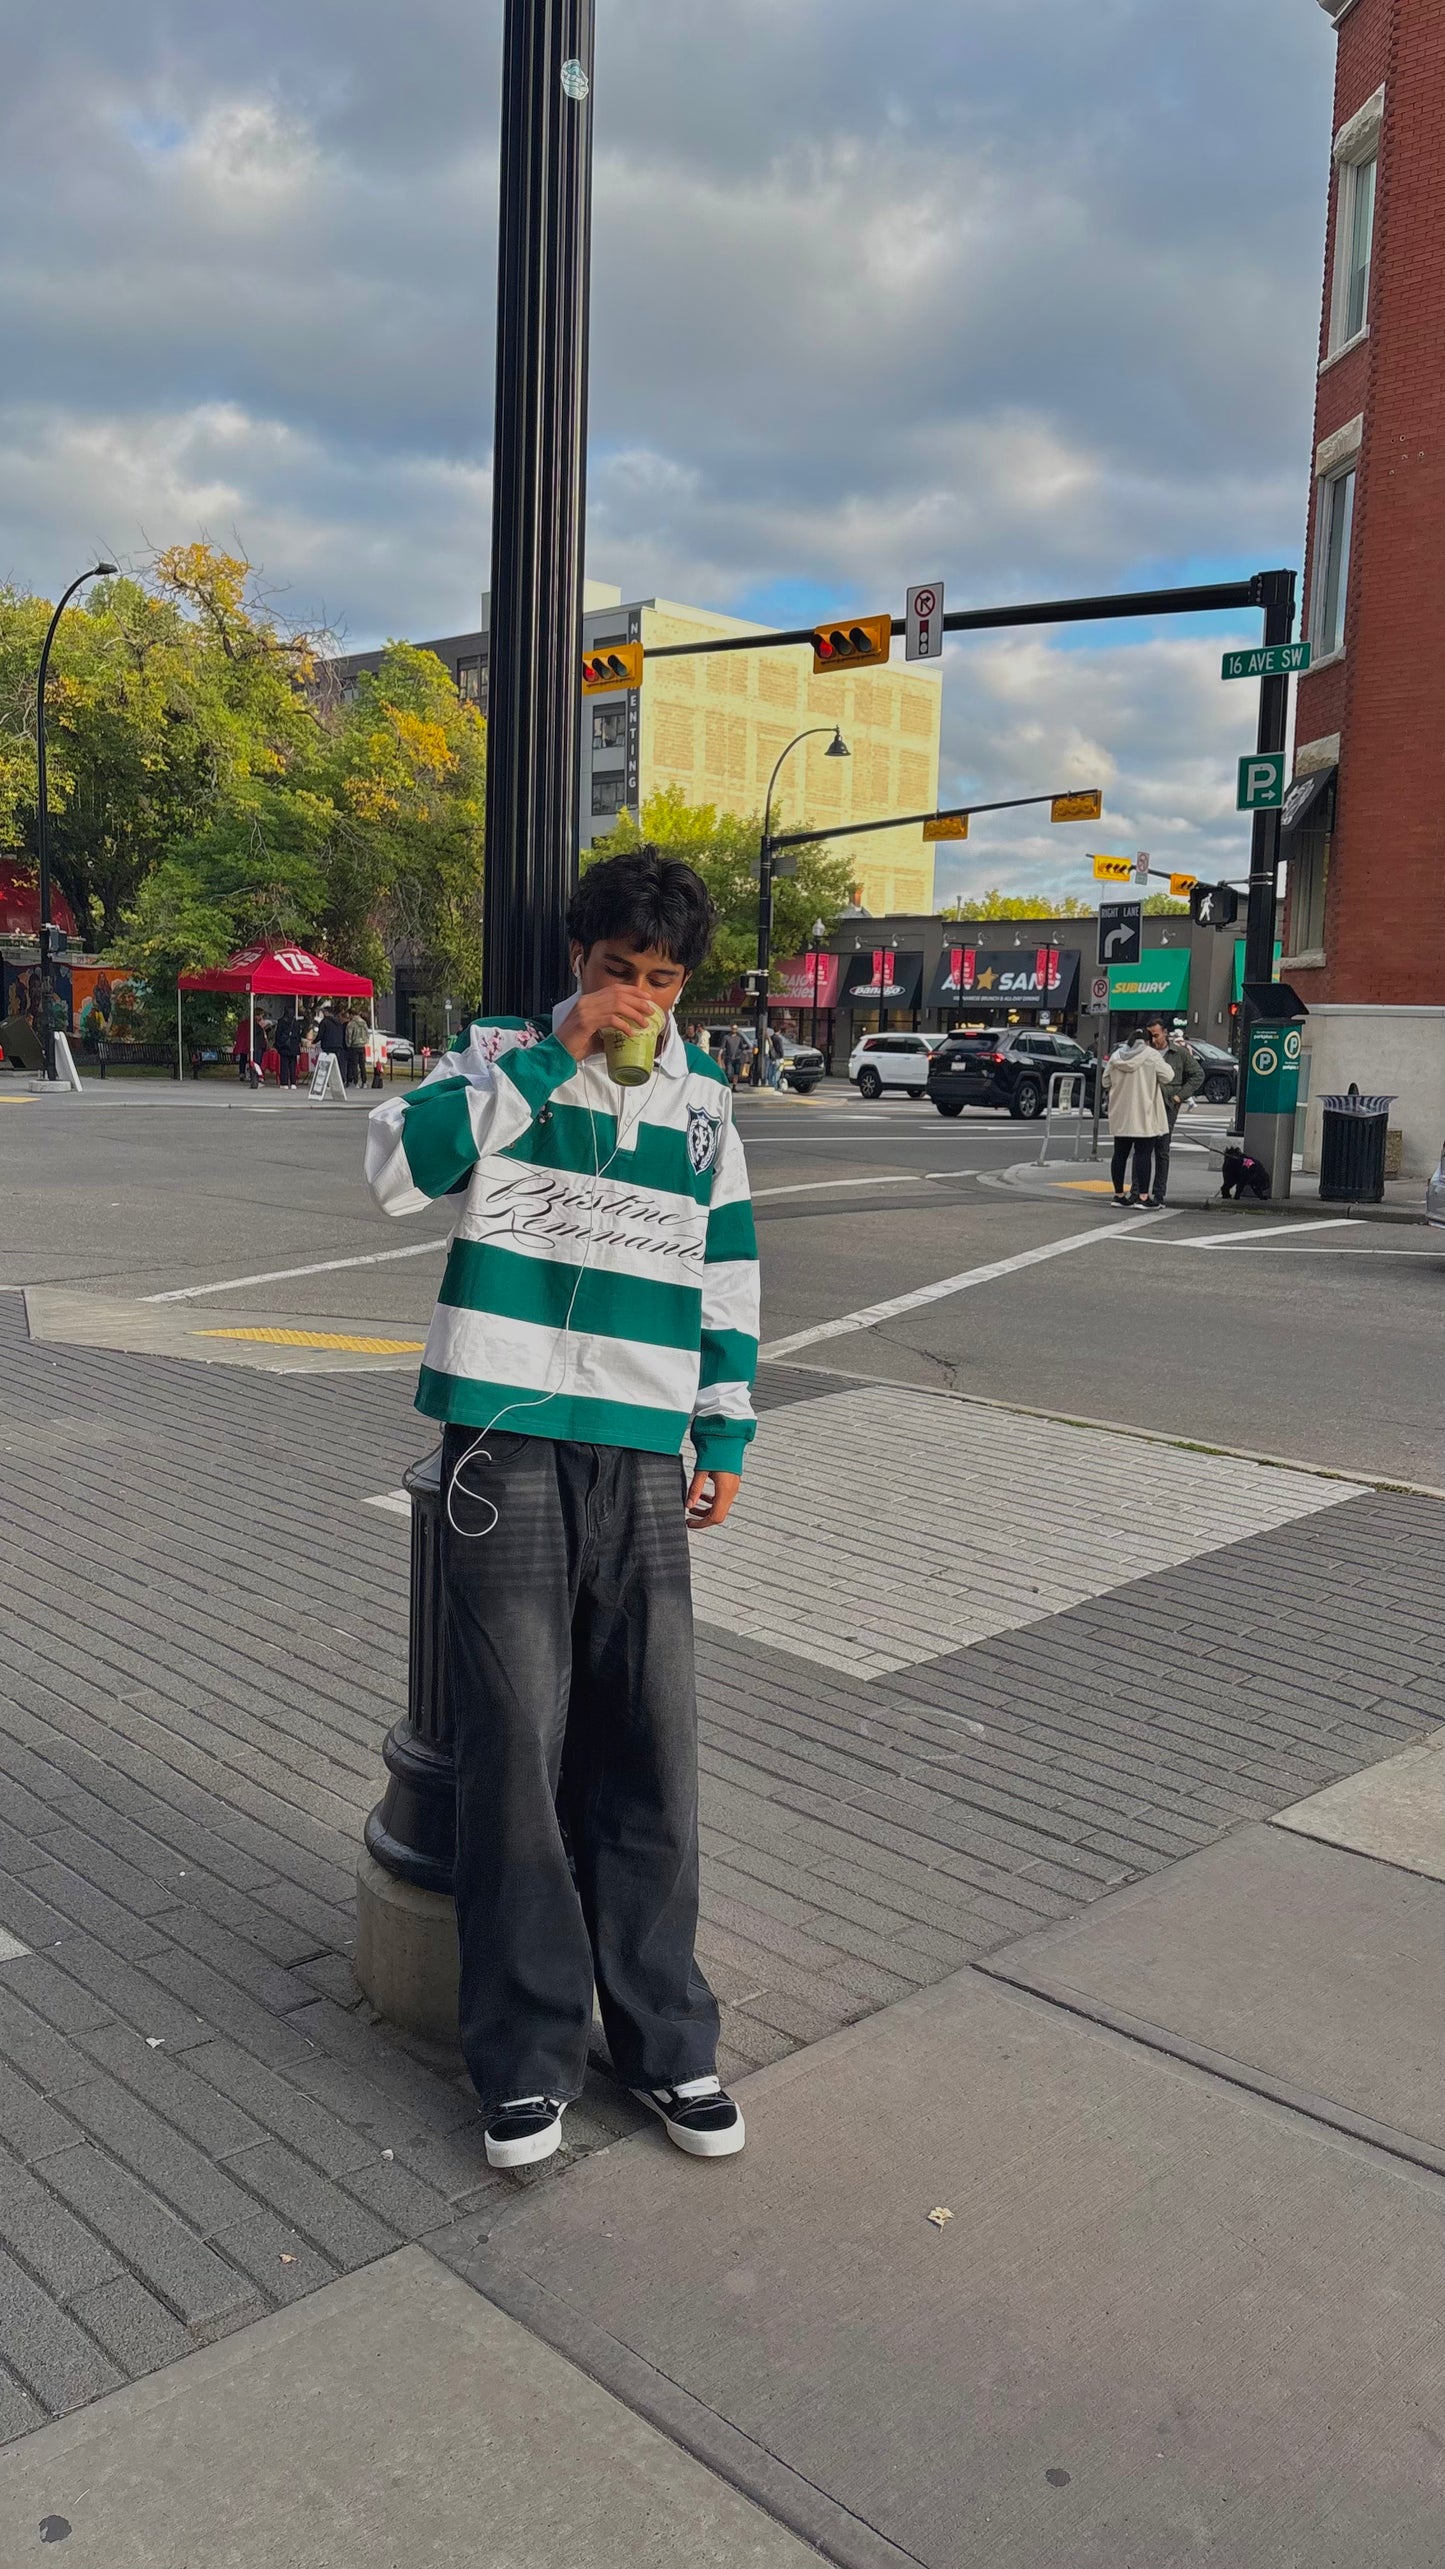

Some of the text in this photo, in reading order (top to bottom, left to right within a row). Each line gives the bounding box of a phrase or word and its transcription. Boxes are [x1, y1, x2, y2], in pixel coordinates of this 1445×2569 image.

[1229, 647, 1304, 675] 16 AVE SW
[1247, 762, 1277, 802] P
[1101, 905, 1140, 918] RIGHT LANE
[1112, 982, 1171, 994] SUBWAY
[473, 1169, 707, 1226] Pristine
[467, 1196, 704, 1260] Remnants
